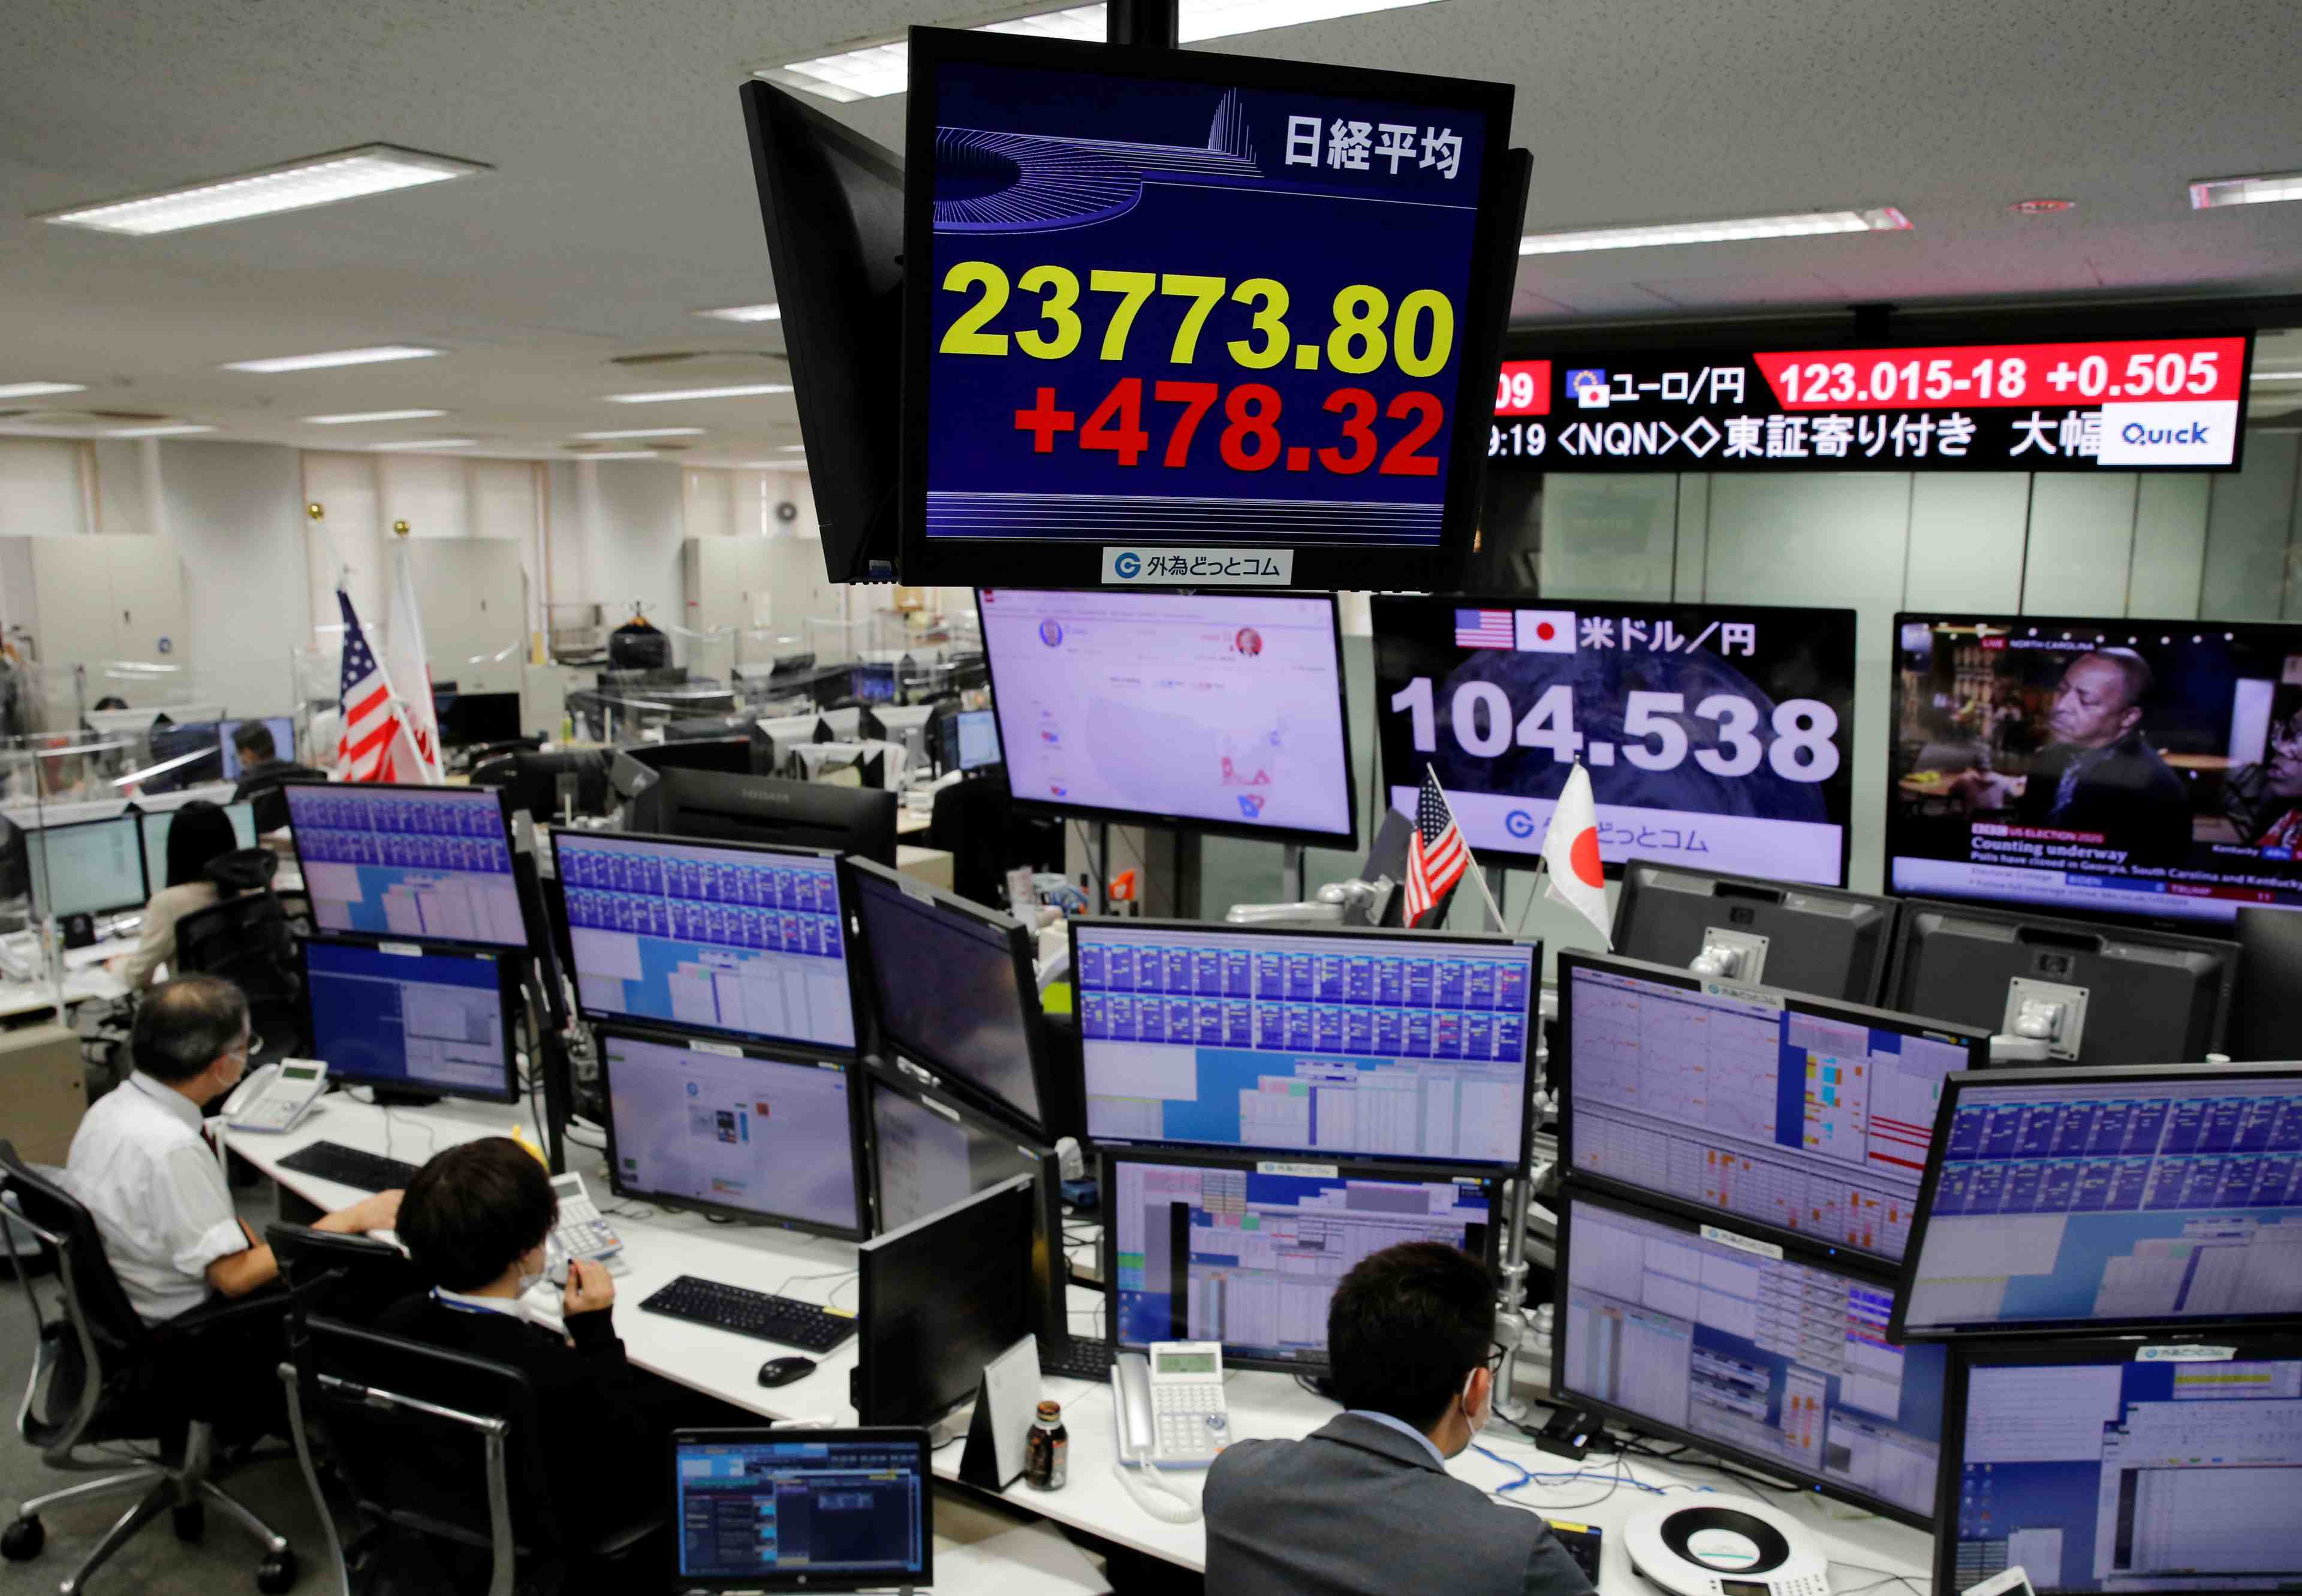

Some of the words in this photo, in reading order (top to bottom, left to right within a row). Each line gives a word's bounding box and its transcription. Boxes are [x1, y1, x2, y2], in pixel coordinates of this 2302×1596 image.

[1285, 115, 1463, 179] 日経平均
[939, 261, 1454, 377] 23773.80
[1779, 358, 2027, 403] 123.015-18
[2046, 352, 2219, 397] +0.505
[1014, 378, 1444, 475] +478.32
[1147, 556, 1280, 577] 外為どっとコム
[1391, 677, 1840, 783] 104.538
[1970, 850, 1998, 862] Polls
[2000, 853, 2027, 865] have
[2029, 856, 2066, 868] closed
[2131, 864, 2167, 877] South
[2167, 868, 2219, 882] Carolina
[2220, 874, 2244, 884] and
[1971, 836, 2043, 858] Counting
[2046, 844, 2128, 864] underway
